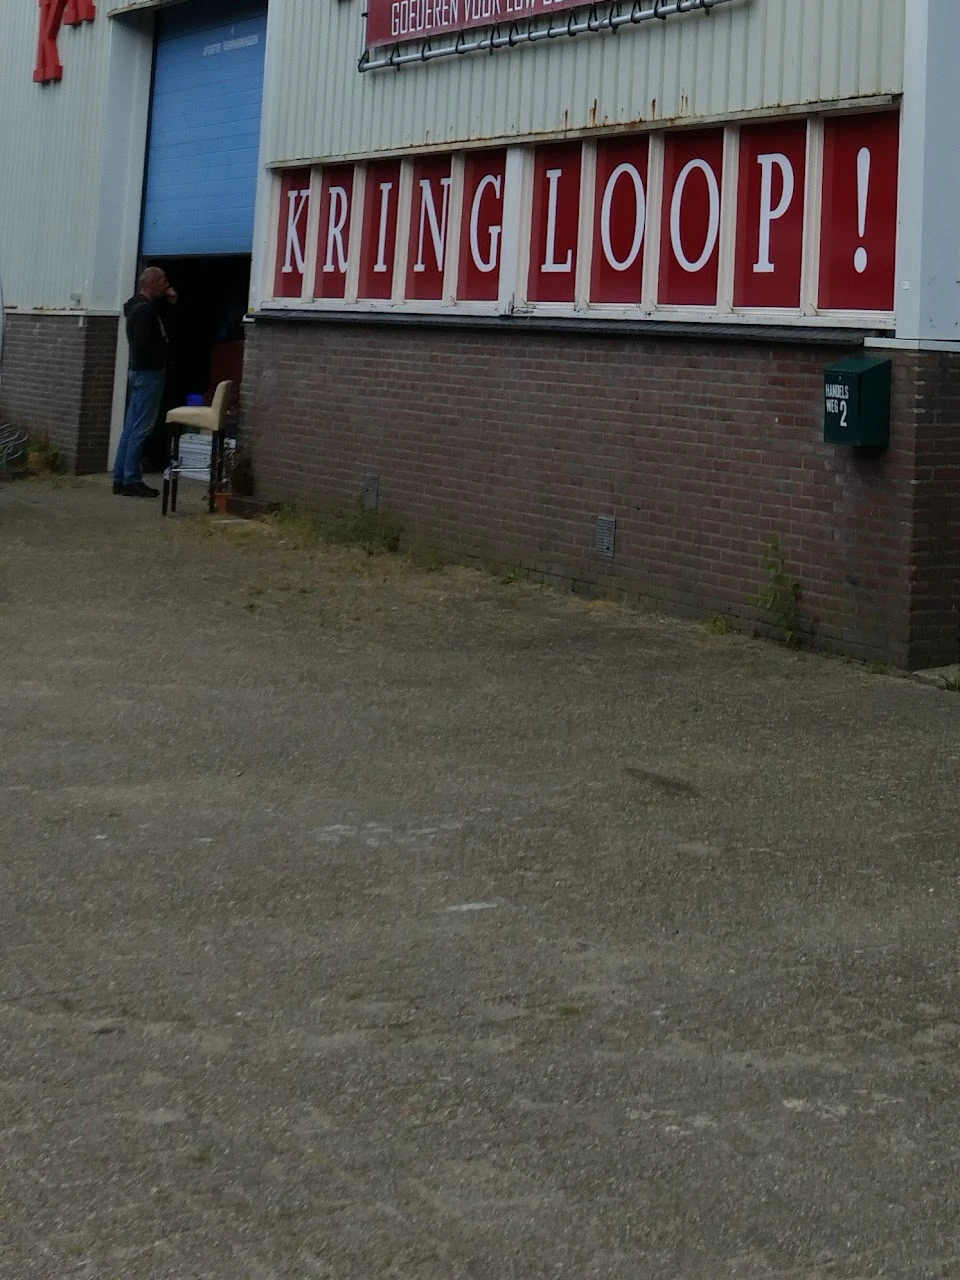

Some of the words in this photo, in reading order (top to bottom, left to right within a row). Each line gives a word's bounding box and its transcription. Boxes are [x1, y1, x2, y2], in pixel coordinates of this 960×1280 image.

[825, 383, 849, 400] HANDELS
[826, 399, 839, 413] WEG
[839, 400, 848, 428] 2
